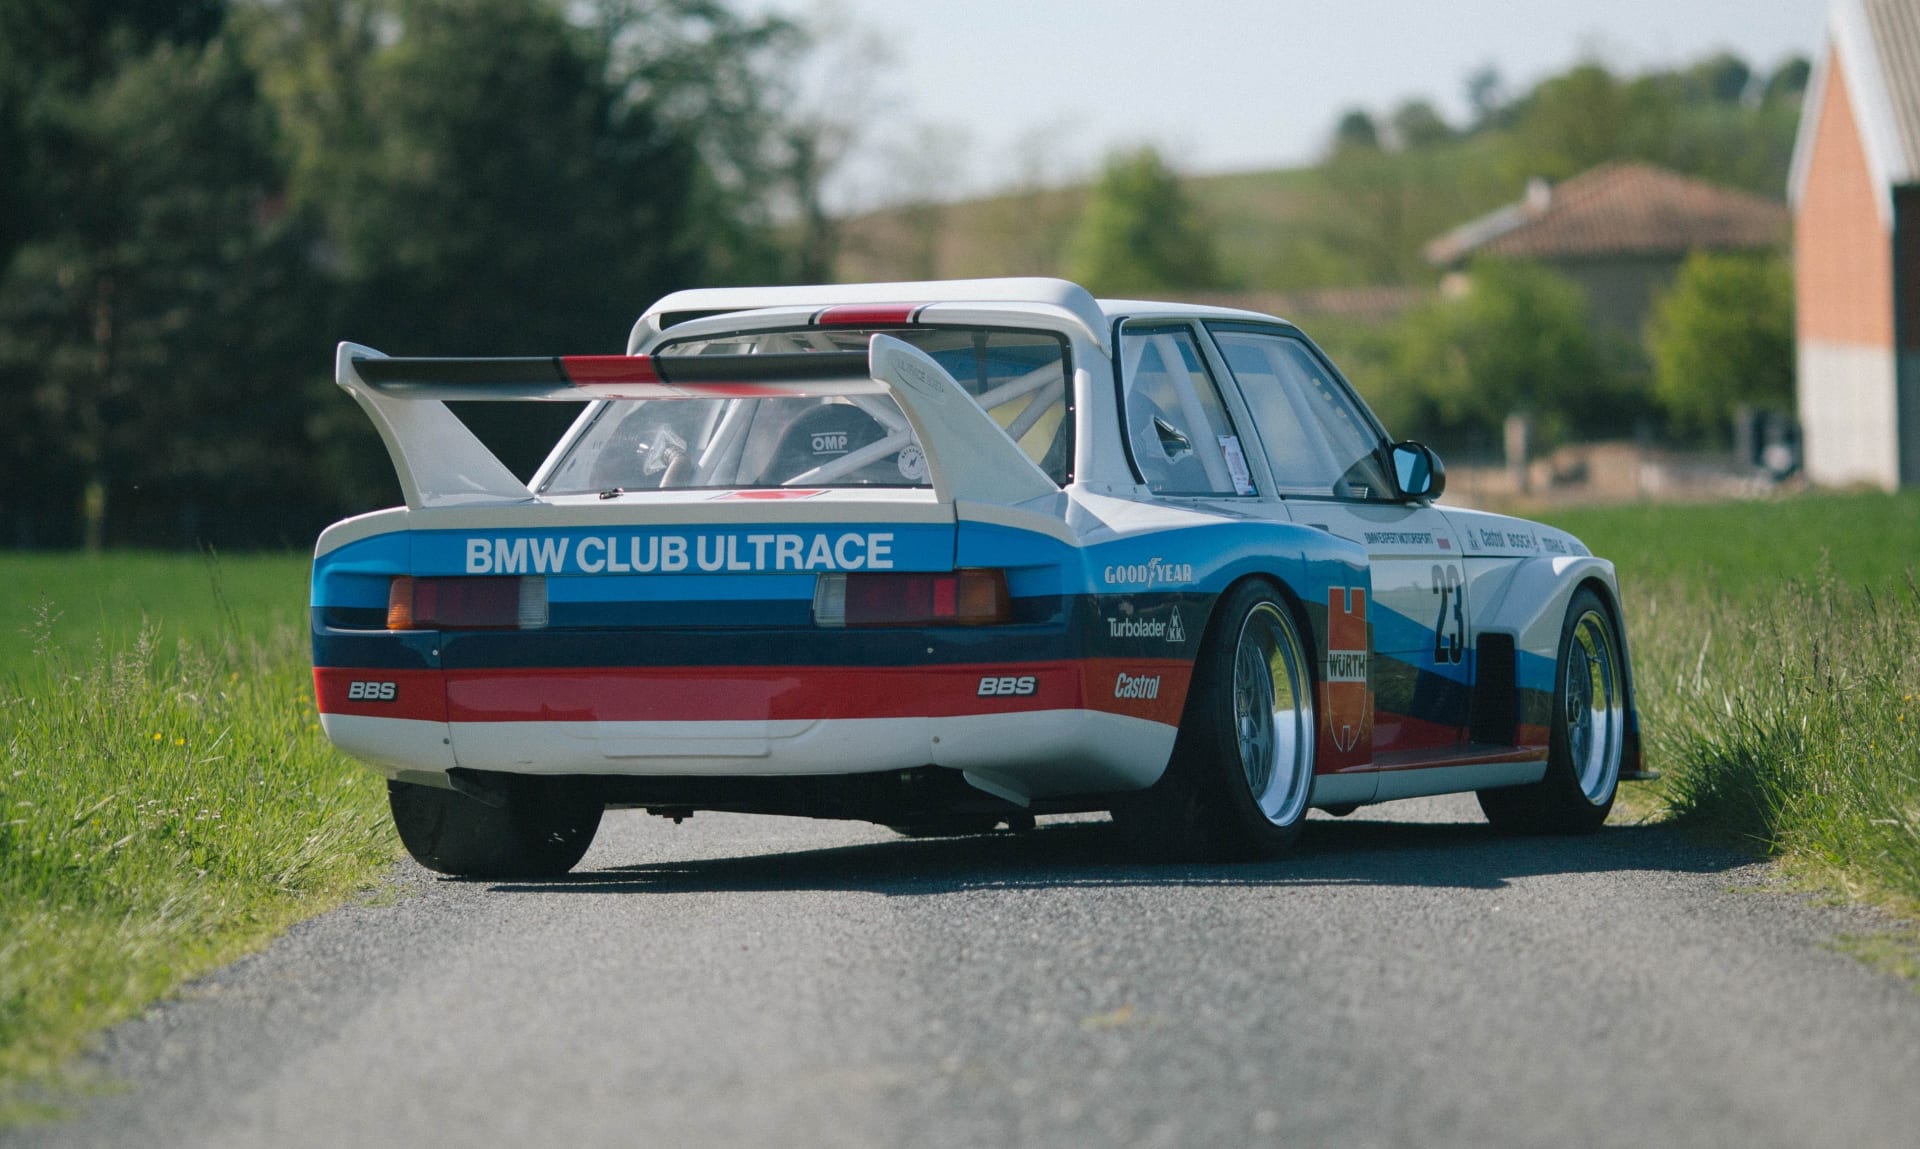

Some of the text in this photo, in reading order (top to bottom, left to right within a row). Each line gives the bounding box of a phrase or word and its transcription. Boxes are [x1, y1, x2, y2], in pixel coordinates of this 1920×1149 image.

[812, 436, 848, 451] OMP
[1480, 528, 1505, 548] Castrol
[1507, 532, 1532, 549] BOSCH
[465, 533, 895, 573] BMW CLUB ULTRACE
[1431, 564, 1465, 666] 23
[1107, 617, 1167, 638] Turbolader
[1328, 653, 1366, 678] WÜRTH
[348, 681, 397, 700] BBS
[977, 676, 1036, 696] BBS
[1114, 672, 1161, 699] Castrol
